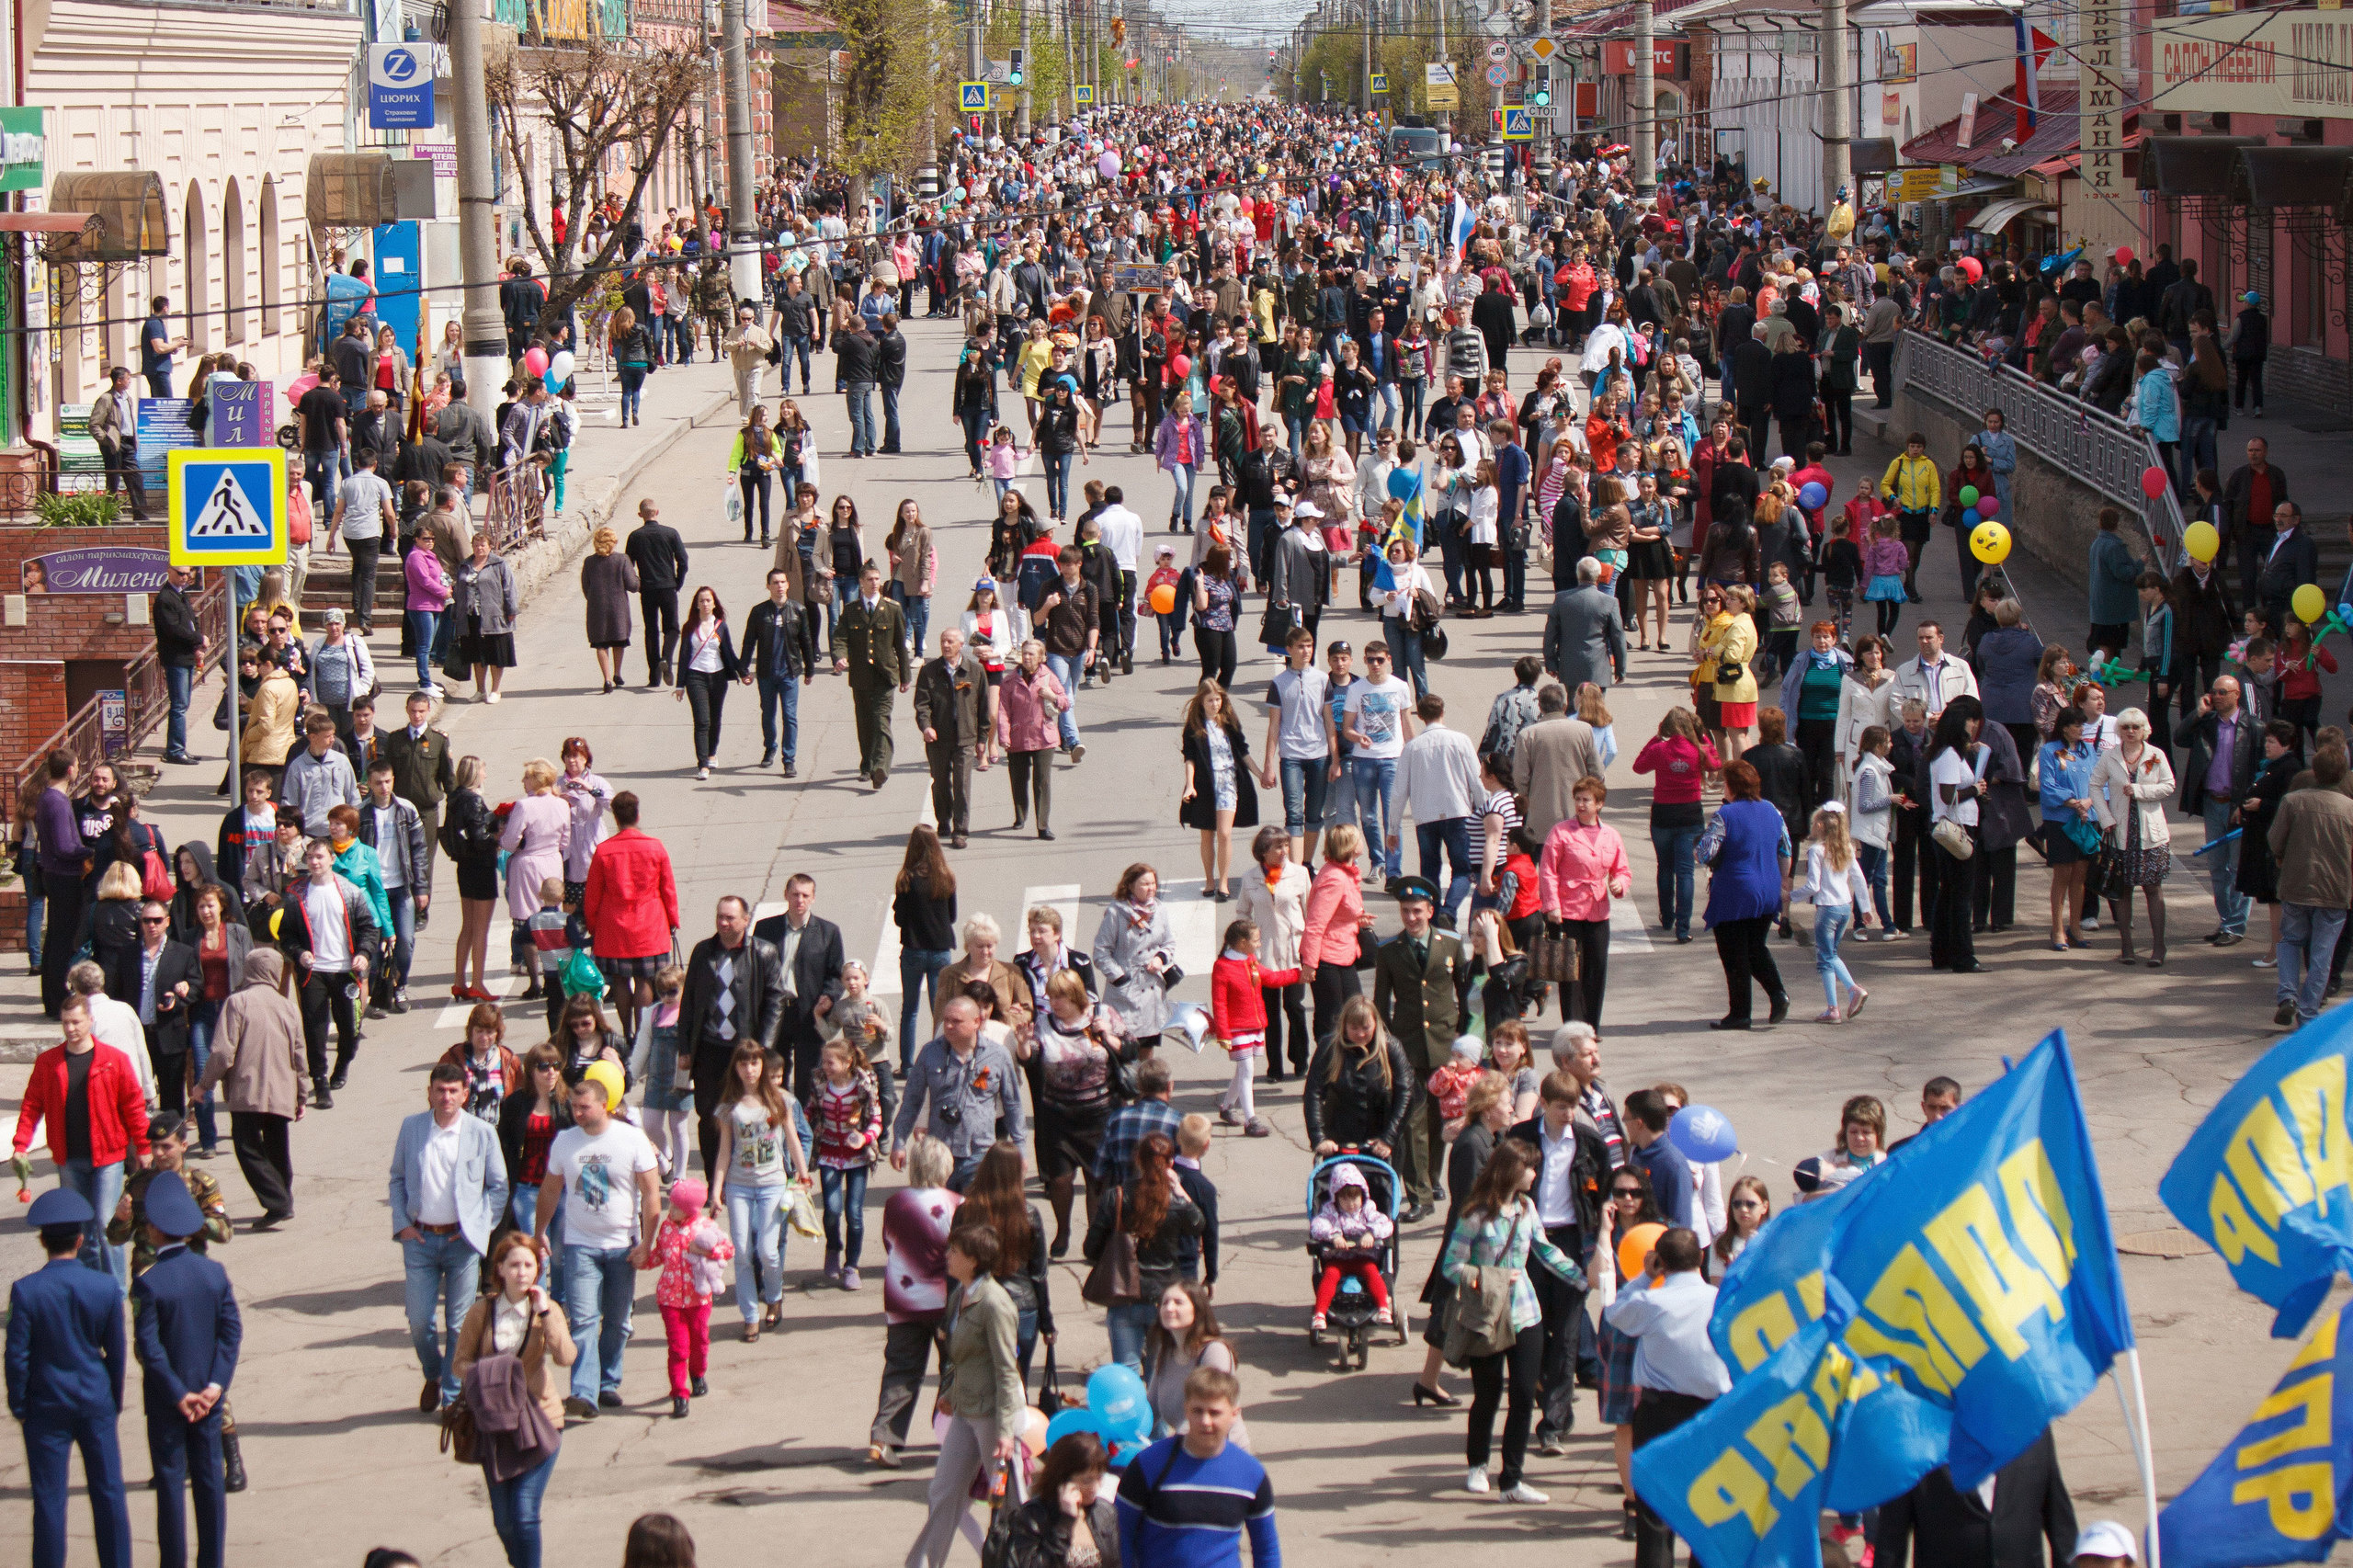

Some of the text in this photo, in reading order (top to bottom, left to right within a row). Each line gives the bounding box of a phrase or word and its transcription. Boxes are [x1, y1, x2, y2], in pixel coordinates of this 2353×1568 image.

[2164, 41, 2276, 84] САЛОН МЕБЕЛИ
[1543, 80, 1549, 91] 3
[380, 95, 420, 103] ЦЮРИХ
[2089, 0, 2115, 187] БЕЛЬМАНИЯ
[1529, 107, 1557, 116] СТОП
[263, 382, 273, 447] парикма
[55, 551, 169, 563] салон парикмахерская
